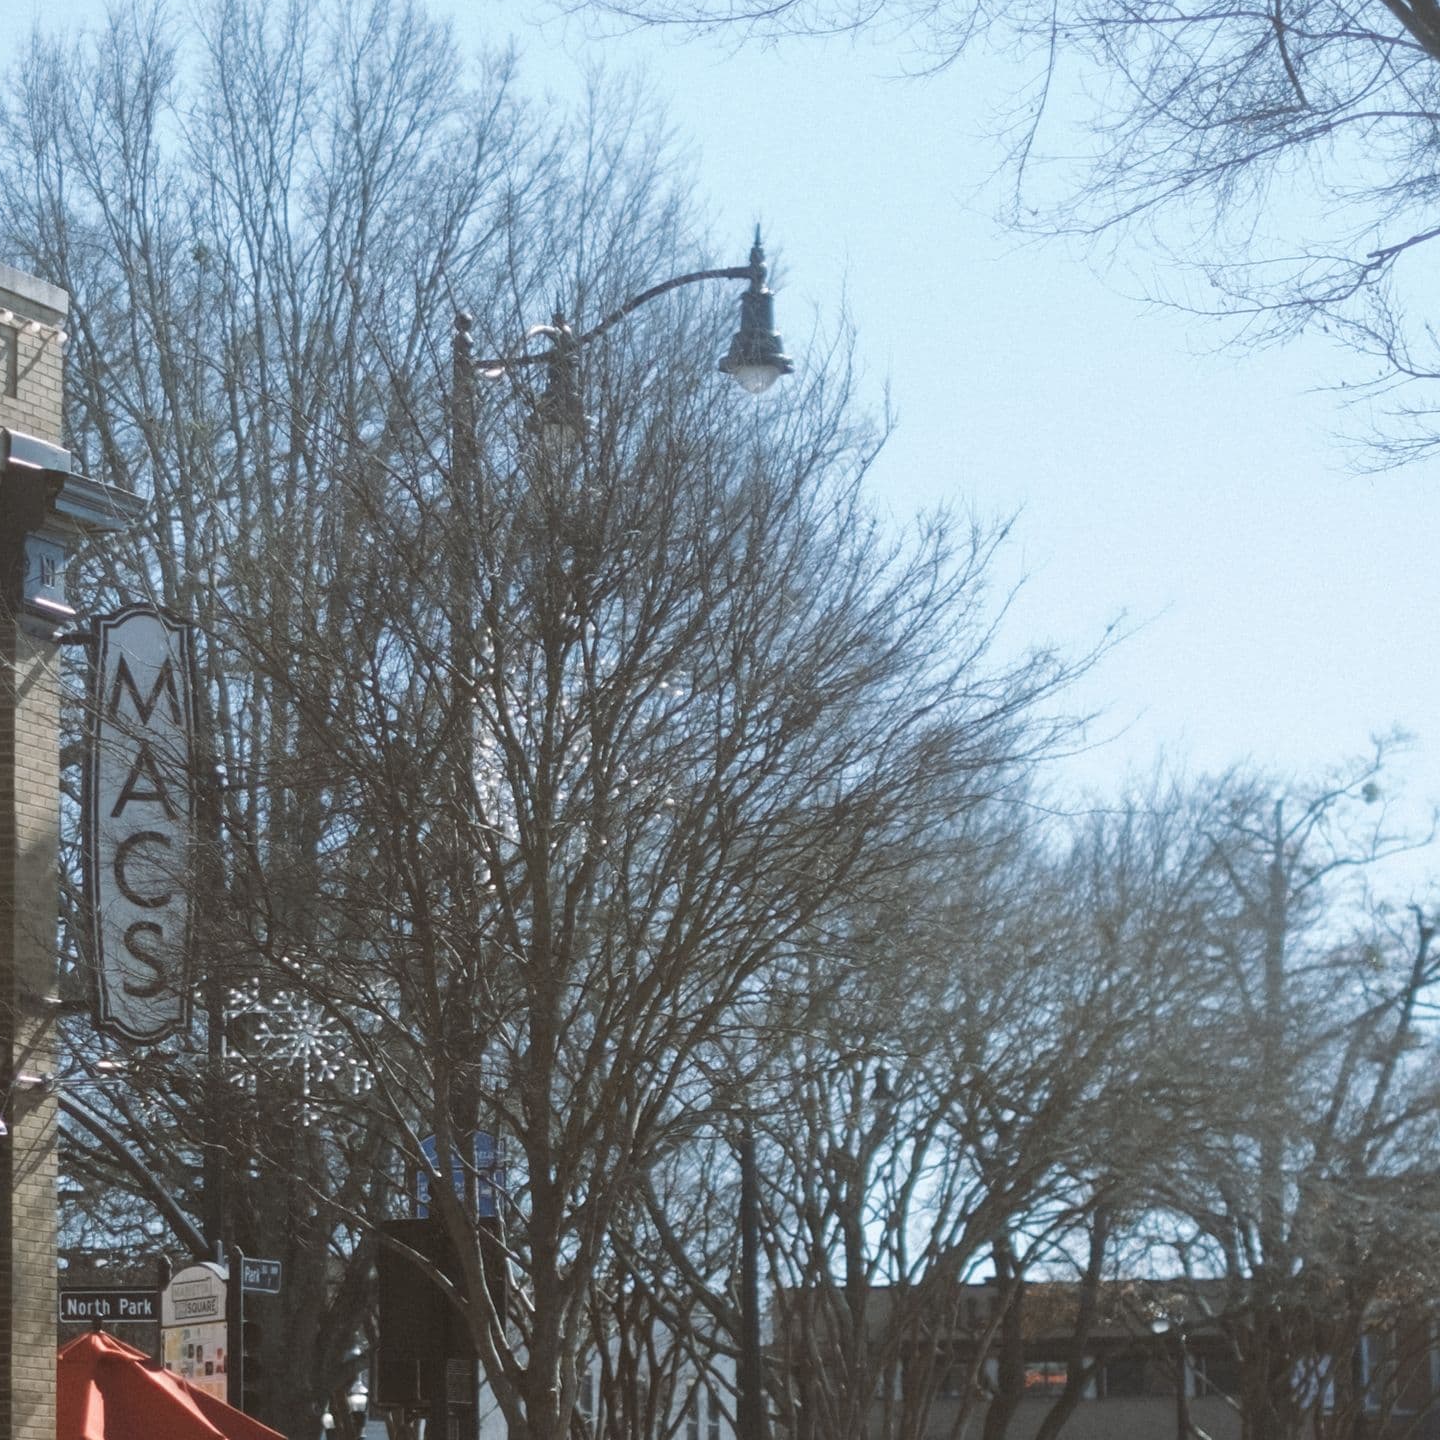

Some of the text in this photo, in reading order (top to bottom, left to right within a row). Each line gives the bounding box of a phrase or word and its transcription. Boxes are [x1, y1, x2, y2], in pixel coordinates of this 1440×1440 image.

[108, 650, 182, 998] MACS
[67, 1297, 153, 1317] North Park
[186, 1298, 217, 1315] SQUARE
